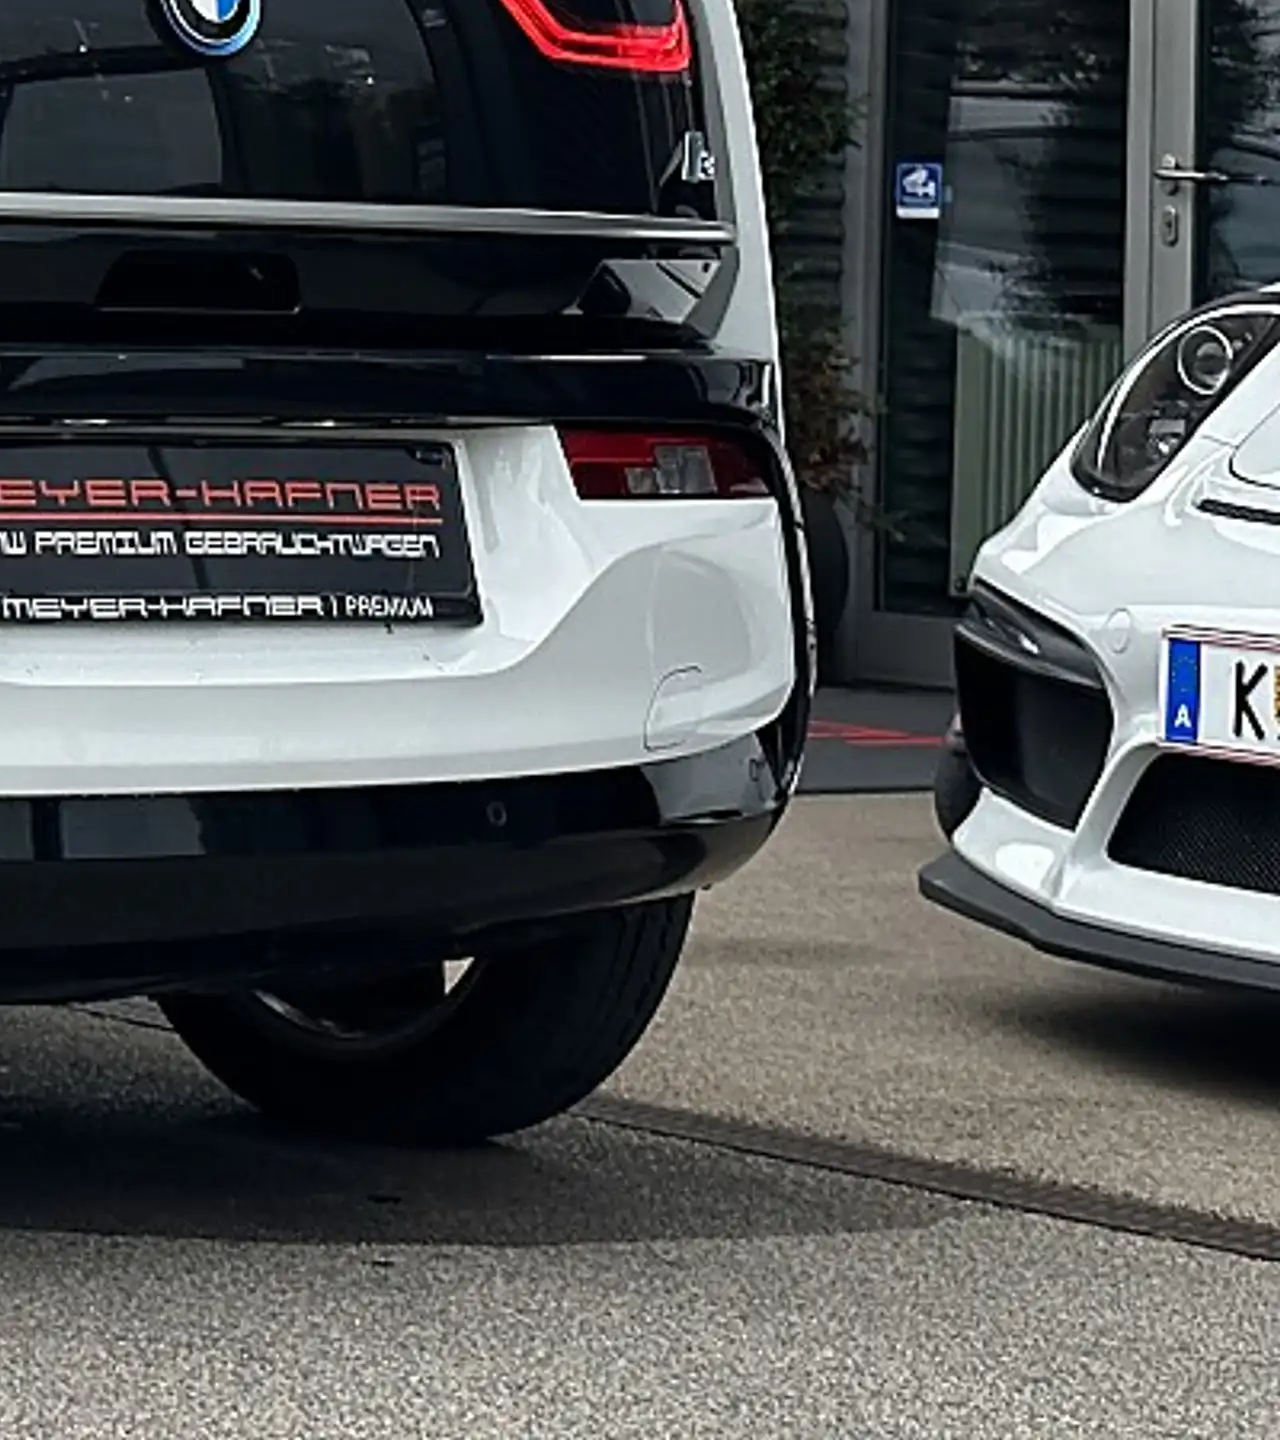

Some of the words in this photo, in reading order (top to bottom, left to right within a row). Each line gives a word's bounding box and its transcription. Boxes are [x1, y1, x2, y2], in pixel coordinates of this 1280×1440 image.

[35, 531, 178, 555] PREMIUM
[184, 531, 440, 558] GEBRAUCHTWAGEN
[2, 596, 324, 619] MEYER-HAFNER
[1174, 703, 1192, 728] A
